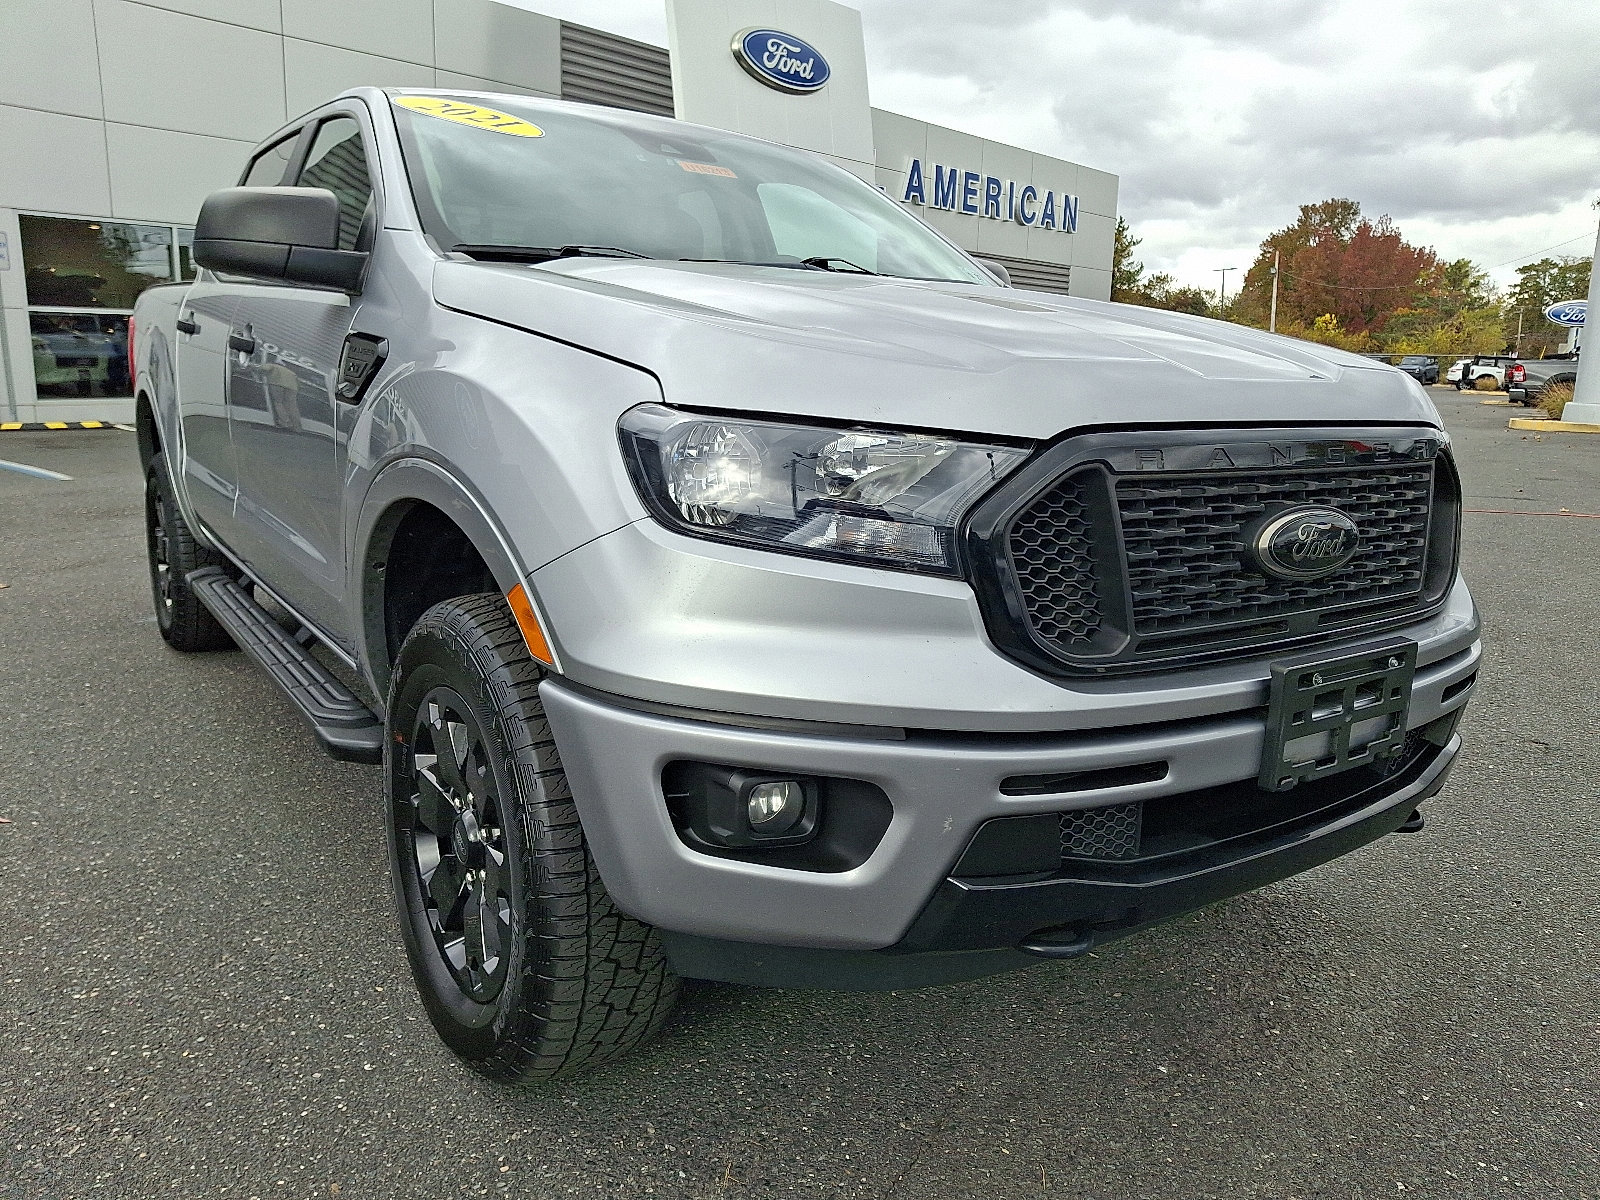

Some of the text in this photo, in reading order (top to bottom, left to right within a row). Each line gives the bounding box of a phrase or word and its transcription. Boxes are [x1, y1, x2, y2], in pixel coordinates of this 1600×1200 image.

[762, 38, 814, 80] Ford
[413, 102, 524, 128] 2021
[901, 156, 1080, 234] AMERICAN
[1560, 305, 1588, 321] For
[1134, 439, 1430, 470] RANGER
[1292, 522, 1345, 560] Ford
